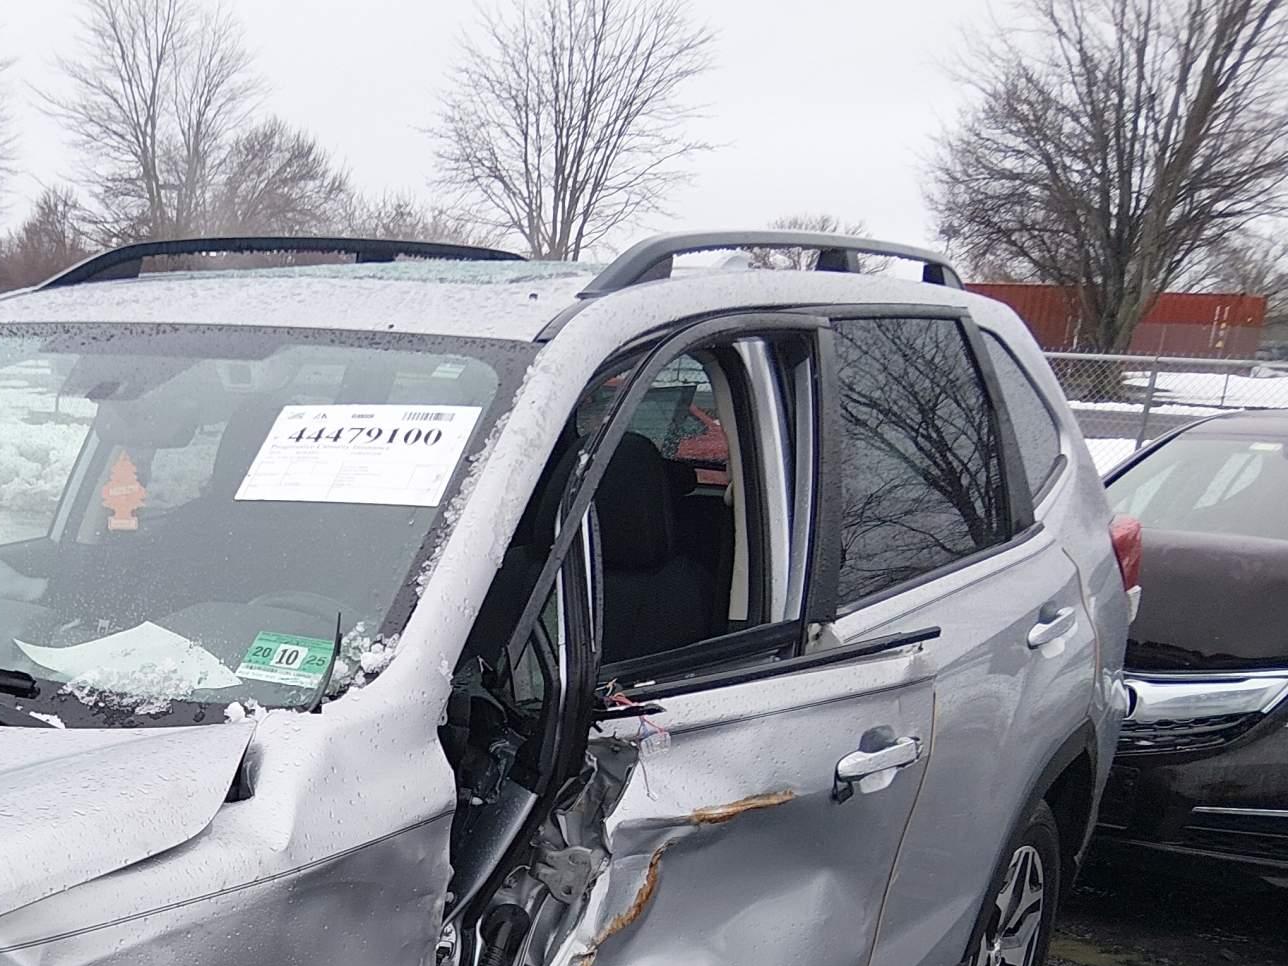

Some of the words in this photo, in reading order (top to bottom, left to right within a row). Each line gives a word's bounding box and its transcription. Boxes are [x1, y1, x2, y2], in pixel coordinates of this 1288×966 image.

[288, 427, 443, 446] 44479100
[252, 646, 273, 658] 20
[275, 648, 299, 666] 10
[305, 655, 327, 667] 25
